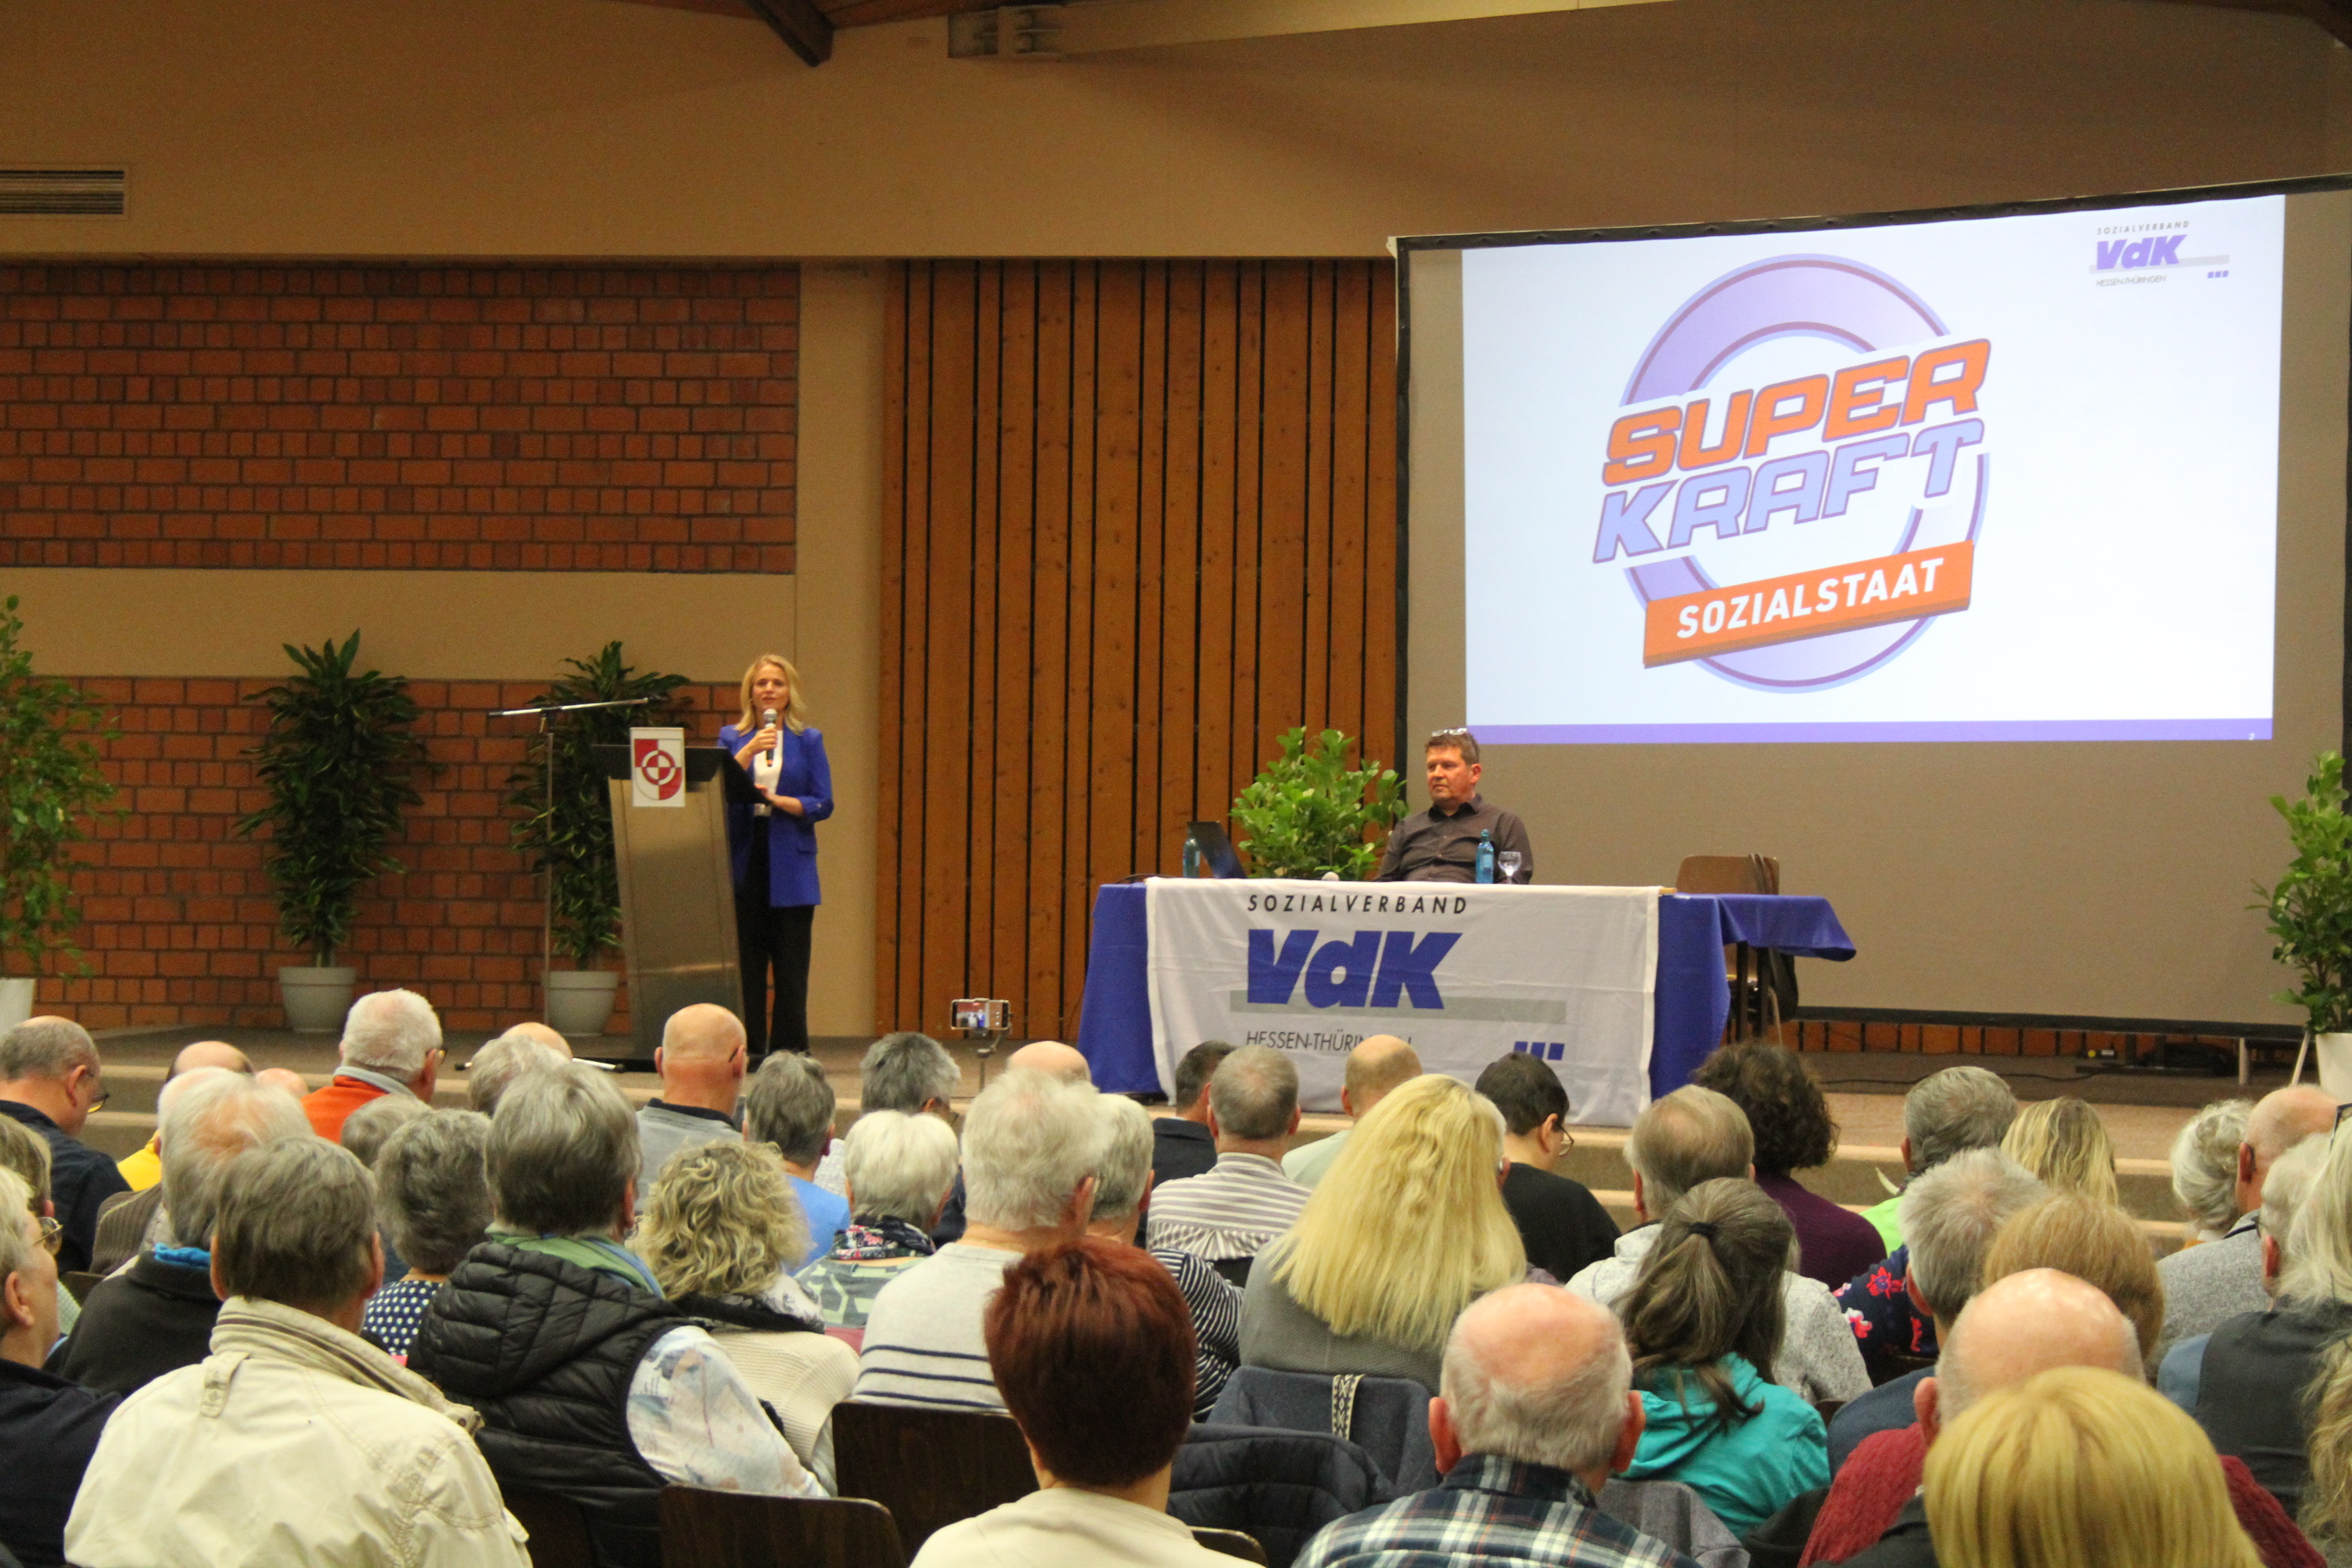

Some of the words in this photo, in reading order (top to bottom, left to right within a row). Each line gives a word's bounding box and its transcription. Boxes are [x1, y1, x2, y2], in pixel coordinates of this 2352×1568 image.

[2096, 234, 2188, 270] VdK
[2097, 221, 2190, 234] SOZIALVERBAND
[1602, 338, 1992, 486] SUPER
[1592, 417, 1985, 564] KRAFT
[1676, 557, 1944, 638] SOZIALSTAAT
[1247, 895, 1467, 914] SOZIALVERBAND
[1247, 927, 1463, 1010] VdK
[1246, 1029, 1412, 1052] HESSEN-THÜRI
